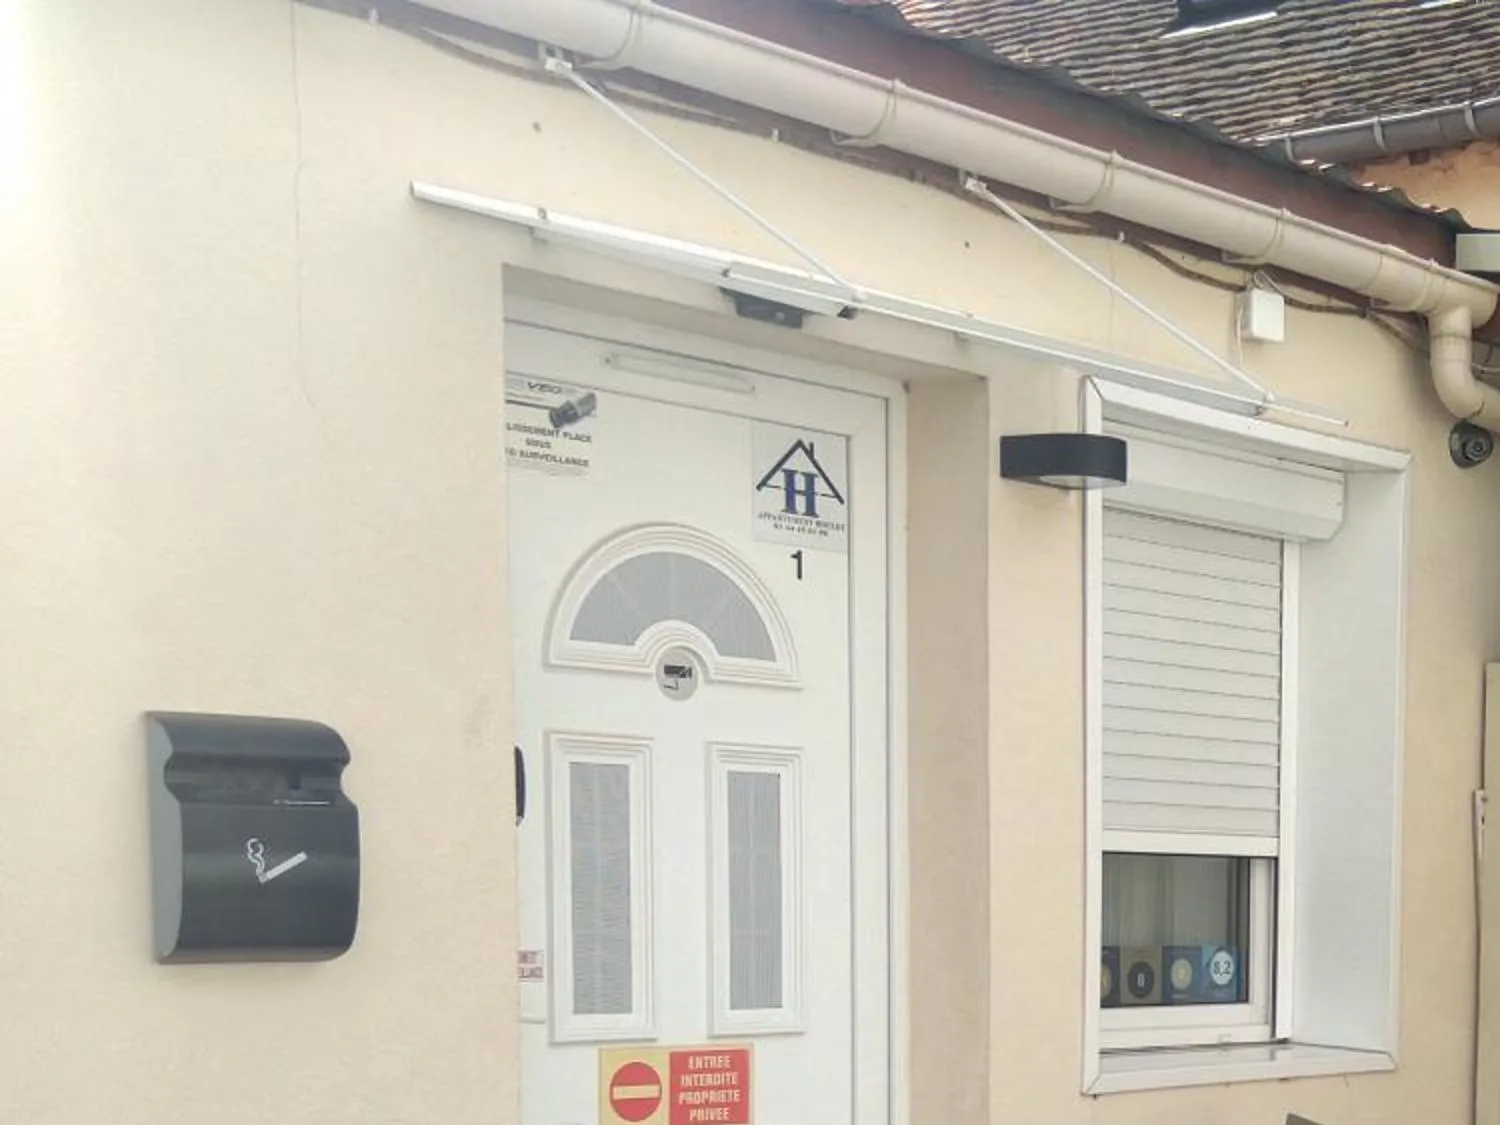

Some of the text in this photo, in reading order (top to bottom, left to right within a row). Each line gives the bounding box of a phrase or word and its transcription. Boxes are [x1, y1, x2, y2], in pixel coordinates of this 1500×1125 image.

[781, 469, 819, 518] H
[789, 549, 802, 580] 1
[687, 1055, 731, 1069] ENTREE
[680, 1071, 738, 1087] INTERDITE
[678, 1089, 741, 1105] PROPRIETE
[688, 1107, 730, 1121] PRIVEE
